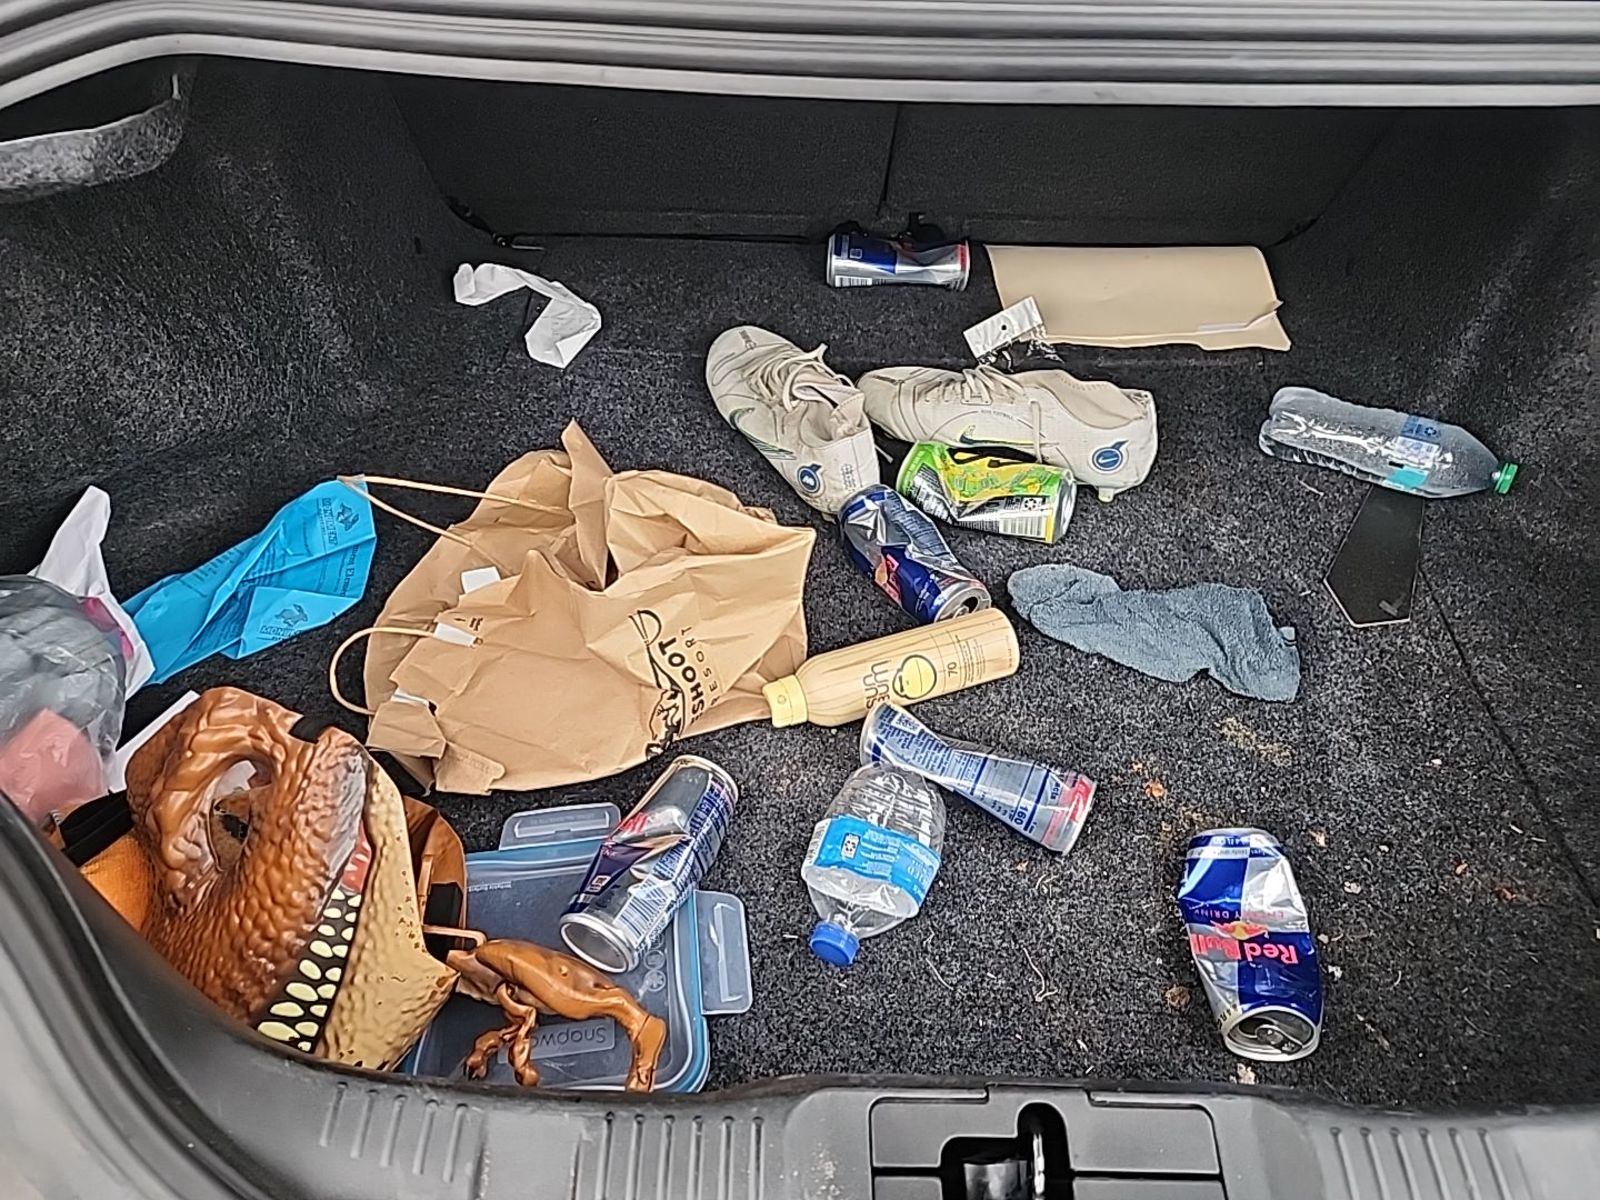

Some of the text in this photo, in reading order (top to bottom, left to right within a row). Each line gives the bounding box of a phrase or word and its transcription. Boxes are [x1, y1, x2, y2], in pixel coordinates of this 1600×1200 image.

[658, 639, 704, 724] SHOOT
[947, 661, 958, 678] 70
[1014, 805, 1029, 825] 160
[1192, 935, 1299, 965] Red Bull
